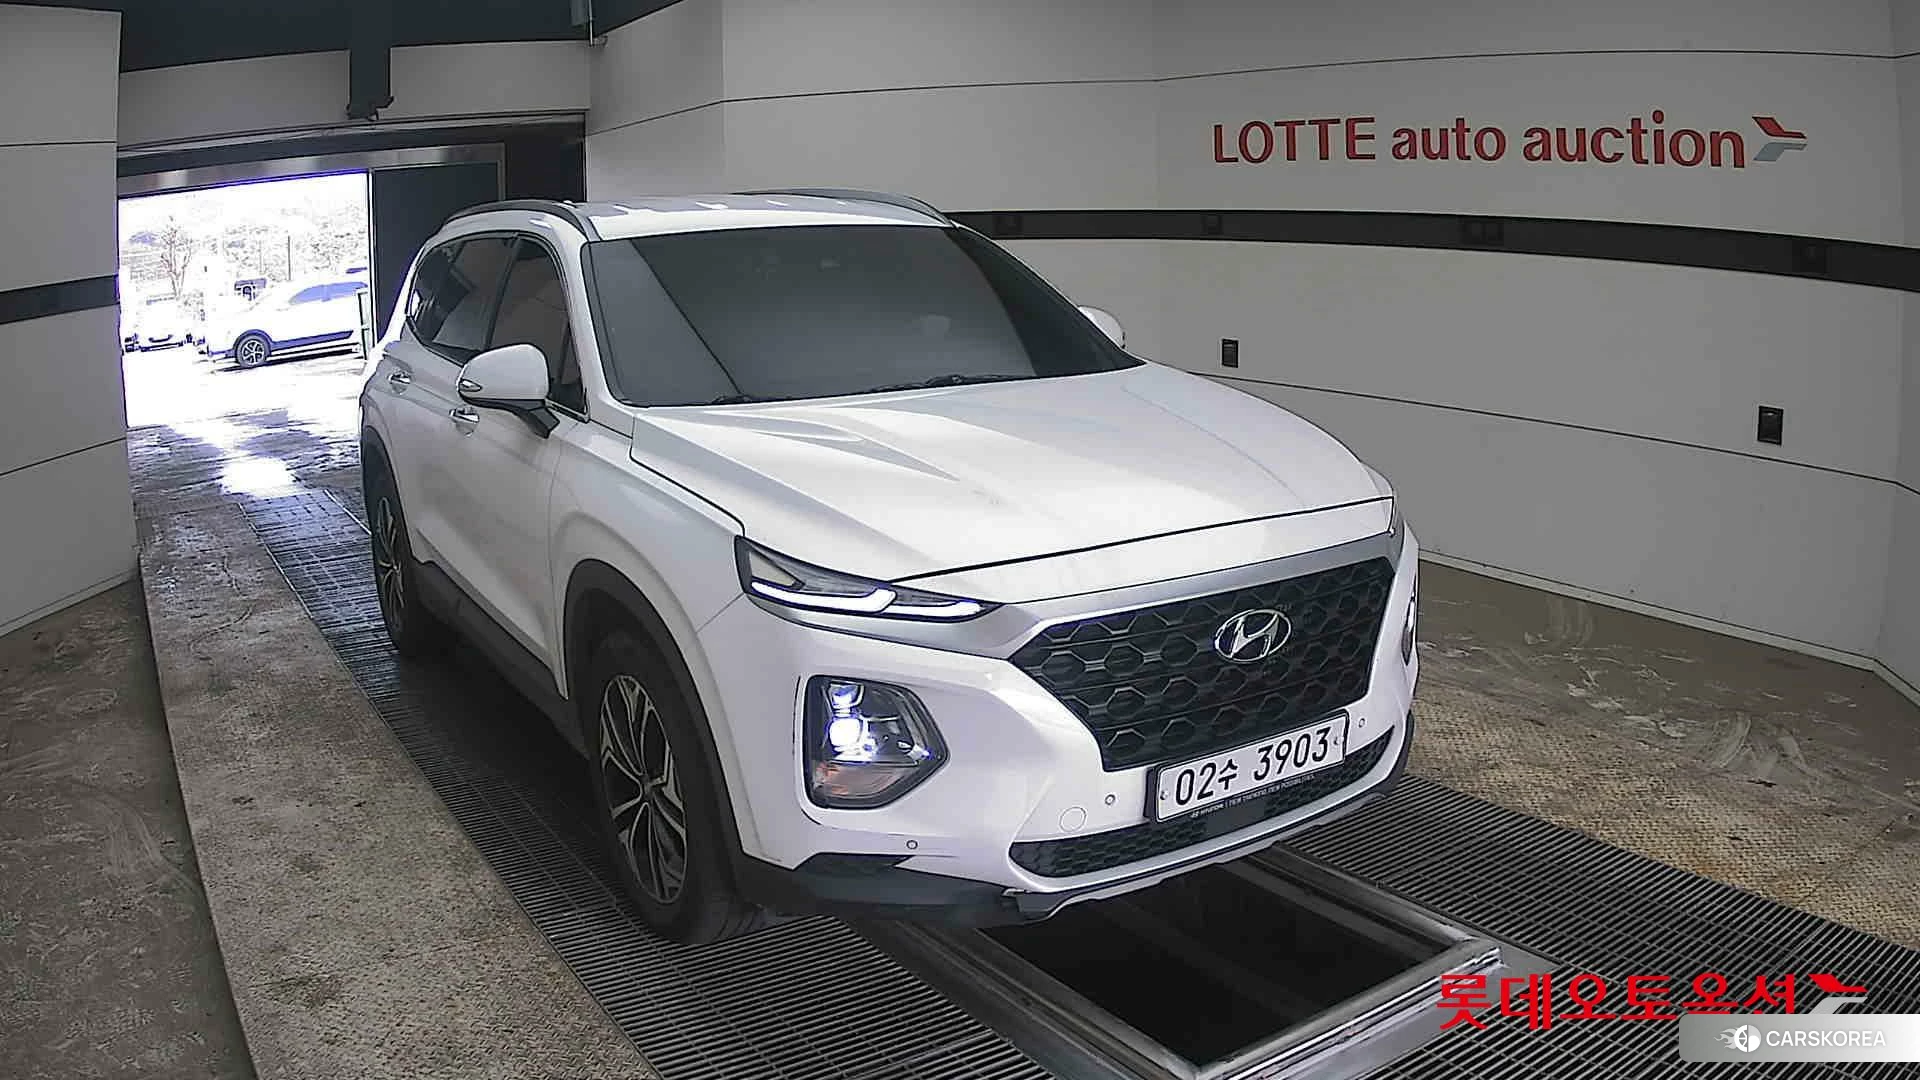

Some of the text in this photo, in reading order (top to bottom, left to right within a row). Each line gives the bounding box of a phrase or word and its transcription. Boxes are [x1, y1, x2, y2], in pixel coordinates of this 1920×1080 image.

[1214, 110, 1746, 169] LOTTE auto auction
[1176, 758, 1238, 805] 02수
[1254, 727, 1330, 781] 3903
